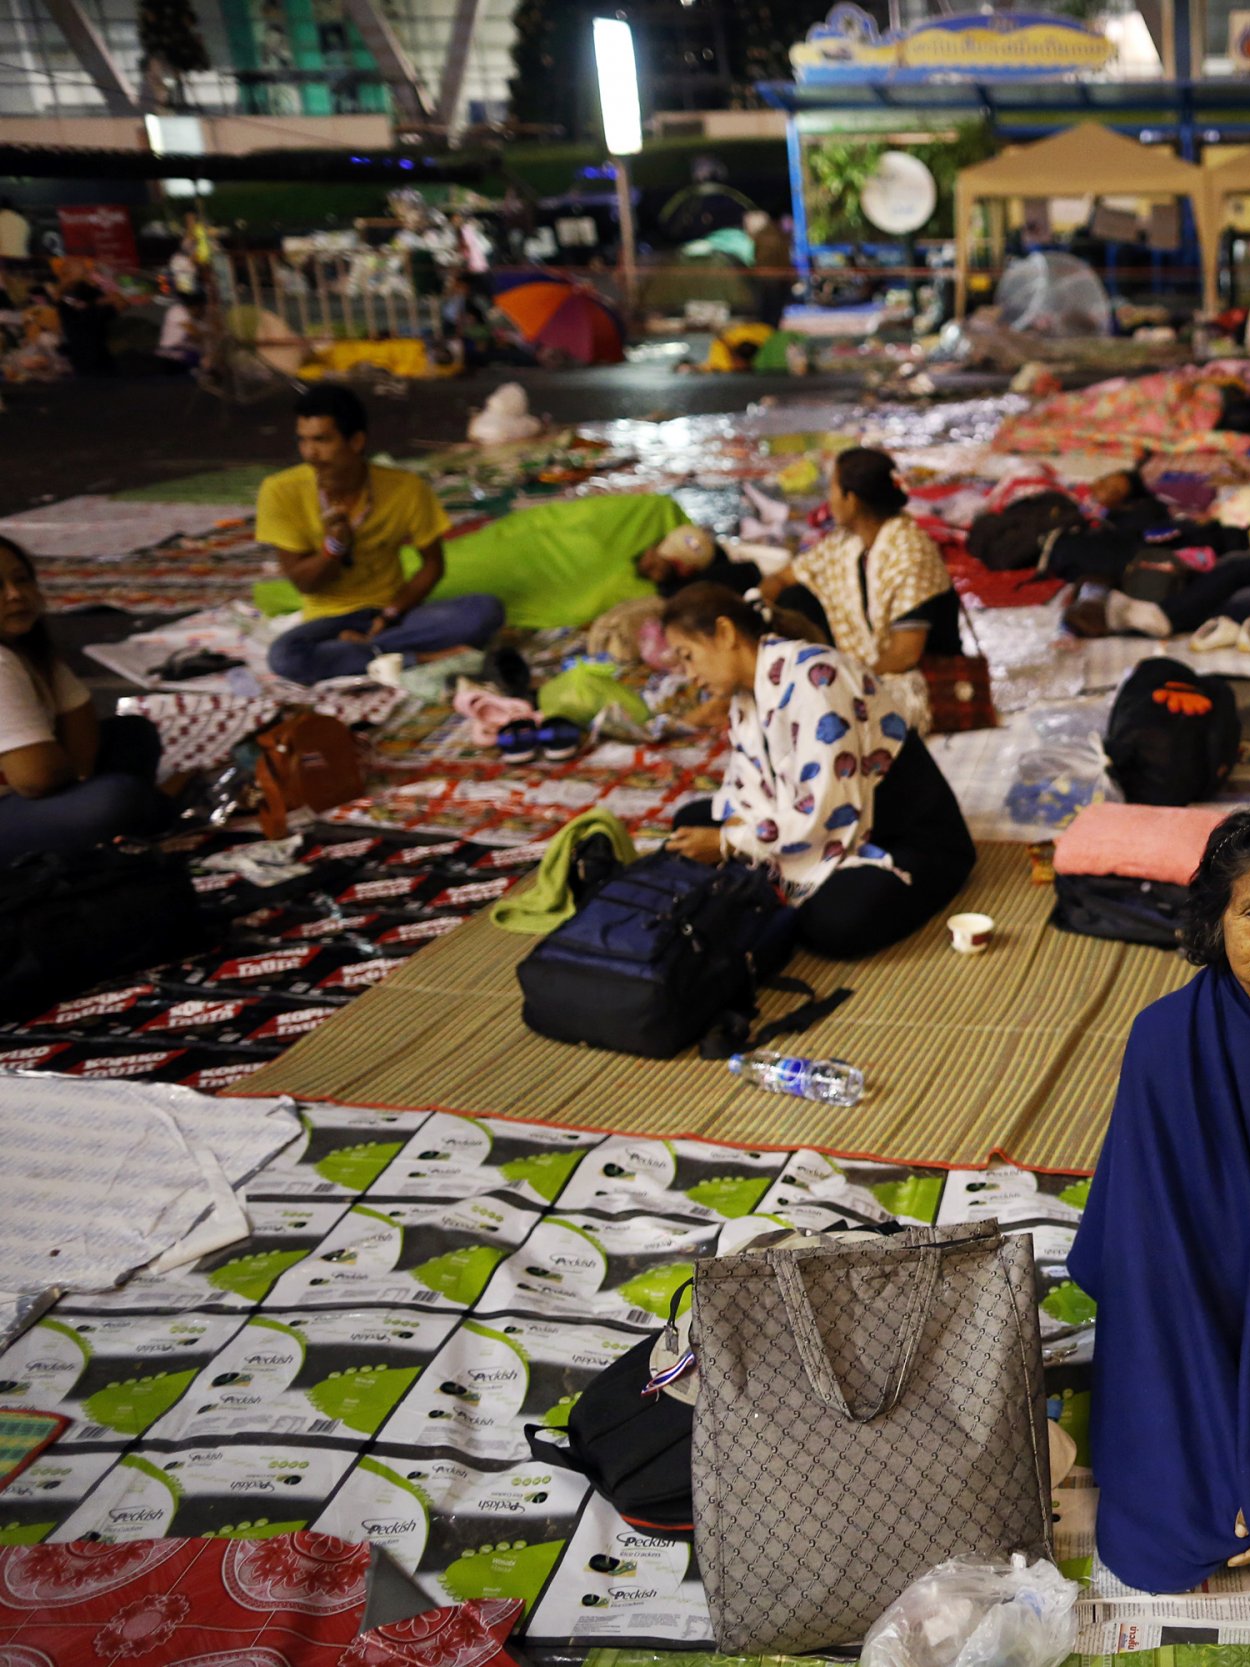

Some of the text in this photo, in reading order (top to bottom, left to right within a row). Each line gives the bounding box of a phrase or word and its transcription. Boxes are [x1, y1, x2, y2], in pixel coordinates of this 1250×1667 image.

[84, 1051, 168, 1069] KOPIKO
[467, 1366, 518, 1382] Peckish
[109, 1504, 164, 1522] Peckish
[478, 1499, 526, 1514] Peckish
[361, 1518, 417, 1537] Peckish
[616, 1531, 676, 1548] Peckish
[608, 1585, 657, 1600] Peckish
